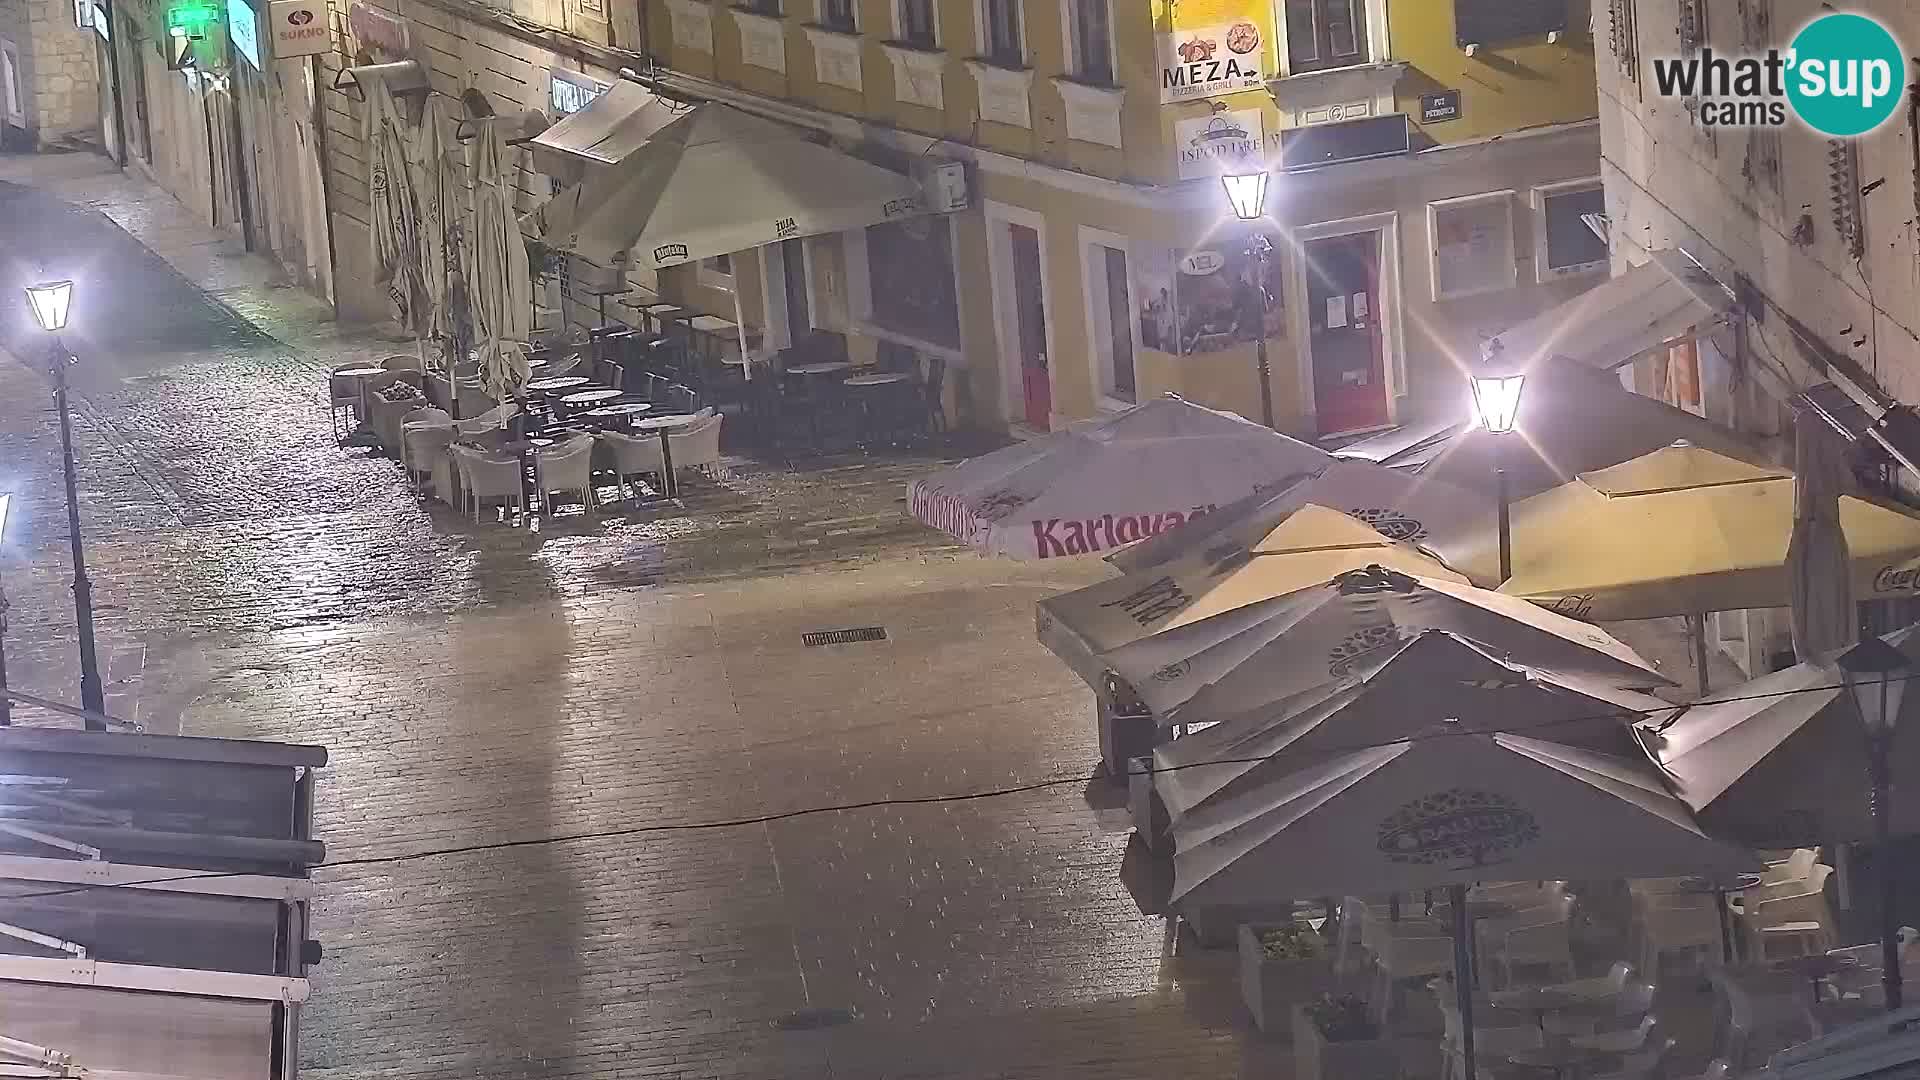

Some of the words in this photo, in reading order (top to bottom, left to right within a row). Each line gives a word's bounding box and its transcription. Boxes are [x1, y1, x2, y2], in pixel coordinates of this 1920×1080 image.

[280, 27, 325, 41] SUKNO
[1163, 58, 1241, 89] MEZA
[1172, 85, 1205, 97] PIZZERIA
[1213, 80, 1232, 91] GRILL
[1181, 144, 1227, 162] ISPOD
